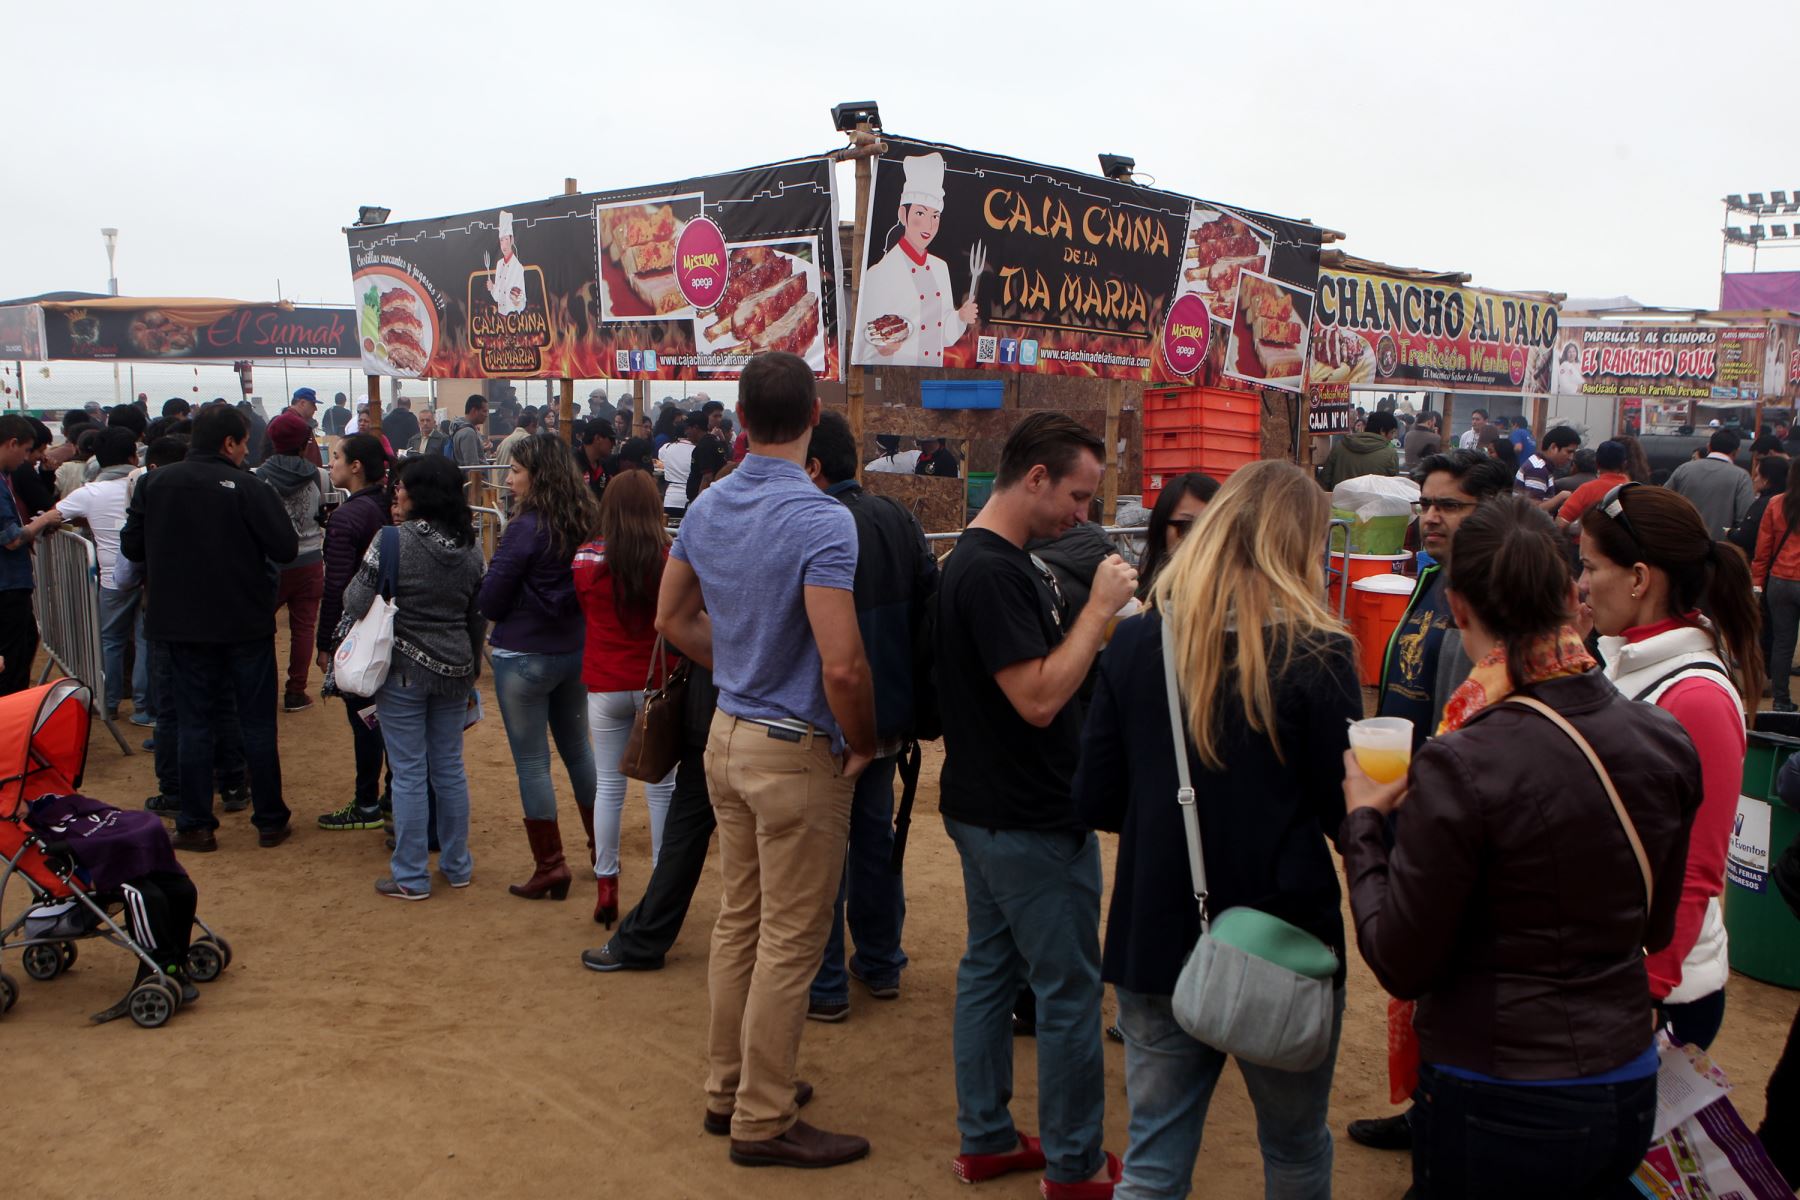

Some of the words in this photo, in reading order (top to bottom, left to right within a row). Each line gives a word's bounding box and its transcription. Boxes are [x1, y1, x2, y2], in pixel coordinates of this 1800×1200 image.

[983, 188, 1073, 241] CAJA
[1082, 205, 1169, 258] CHINA
[1063, 247, 1081, 264] DE
[1084, 250, 1098, 267] LA
[691, 277, 713, 290] apega
[999, 266, 1050, 311] TIA
[1059, 271, 1146, 322] MARIA
[1315, 274, 1465, 338] CHANCHO
[1469, 295, 1499, 343] AL
[1502, 300, 1558, 349] PALO
[207, 310, 252, 347] El
[254, 312, 345, 346] Sumak
[472, 315, 505, 336] CAJA
[507, 311, 547, 335] CHINA
[1583, 331, 1641, 343] PARRILLAS
[1645, 331, 1659, 343] AL
[1662, 332, 1717, 344] CILINDRO
[275, 346, 337, 355] CILINDRO
[1040, 347, 1150, 368] www.cajachinadelatiamaria.com
[1175, 345, 1196, 358] apega
[1398, 338, 1467, 371] Tradición
[1580, 347, 1599, 376] EL
[1600, 346, 1675, 377] RANCHITO
[1675, 347, 1717, 380] BULL
[1582, 383, 1618, 395] Bautizado
[1619, 385, 1638, 395] como
[1639, 384, 1647, 394] la
[1678, 385, 1709, 397] Peruana
[1310, 412, 1329, 430] CAJA
[1340, 411, 1349, 428] 01
[1735, 838, 1767, 857] Eventos
[1738, 868, 1762, 882] FERIAS
